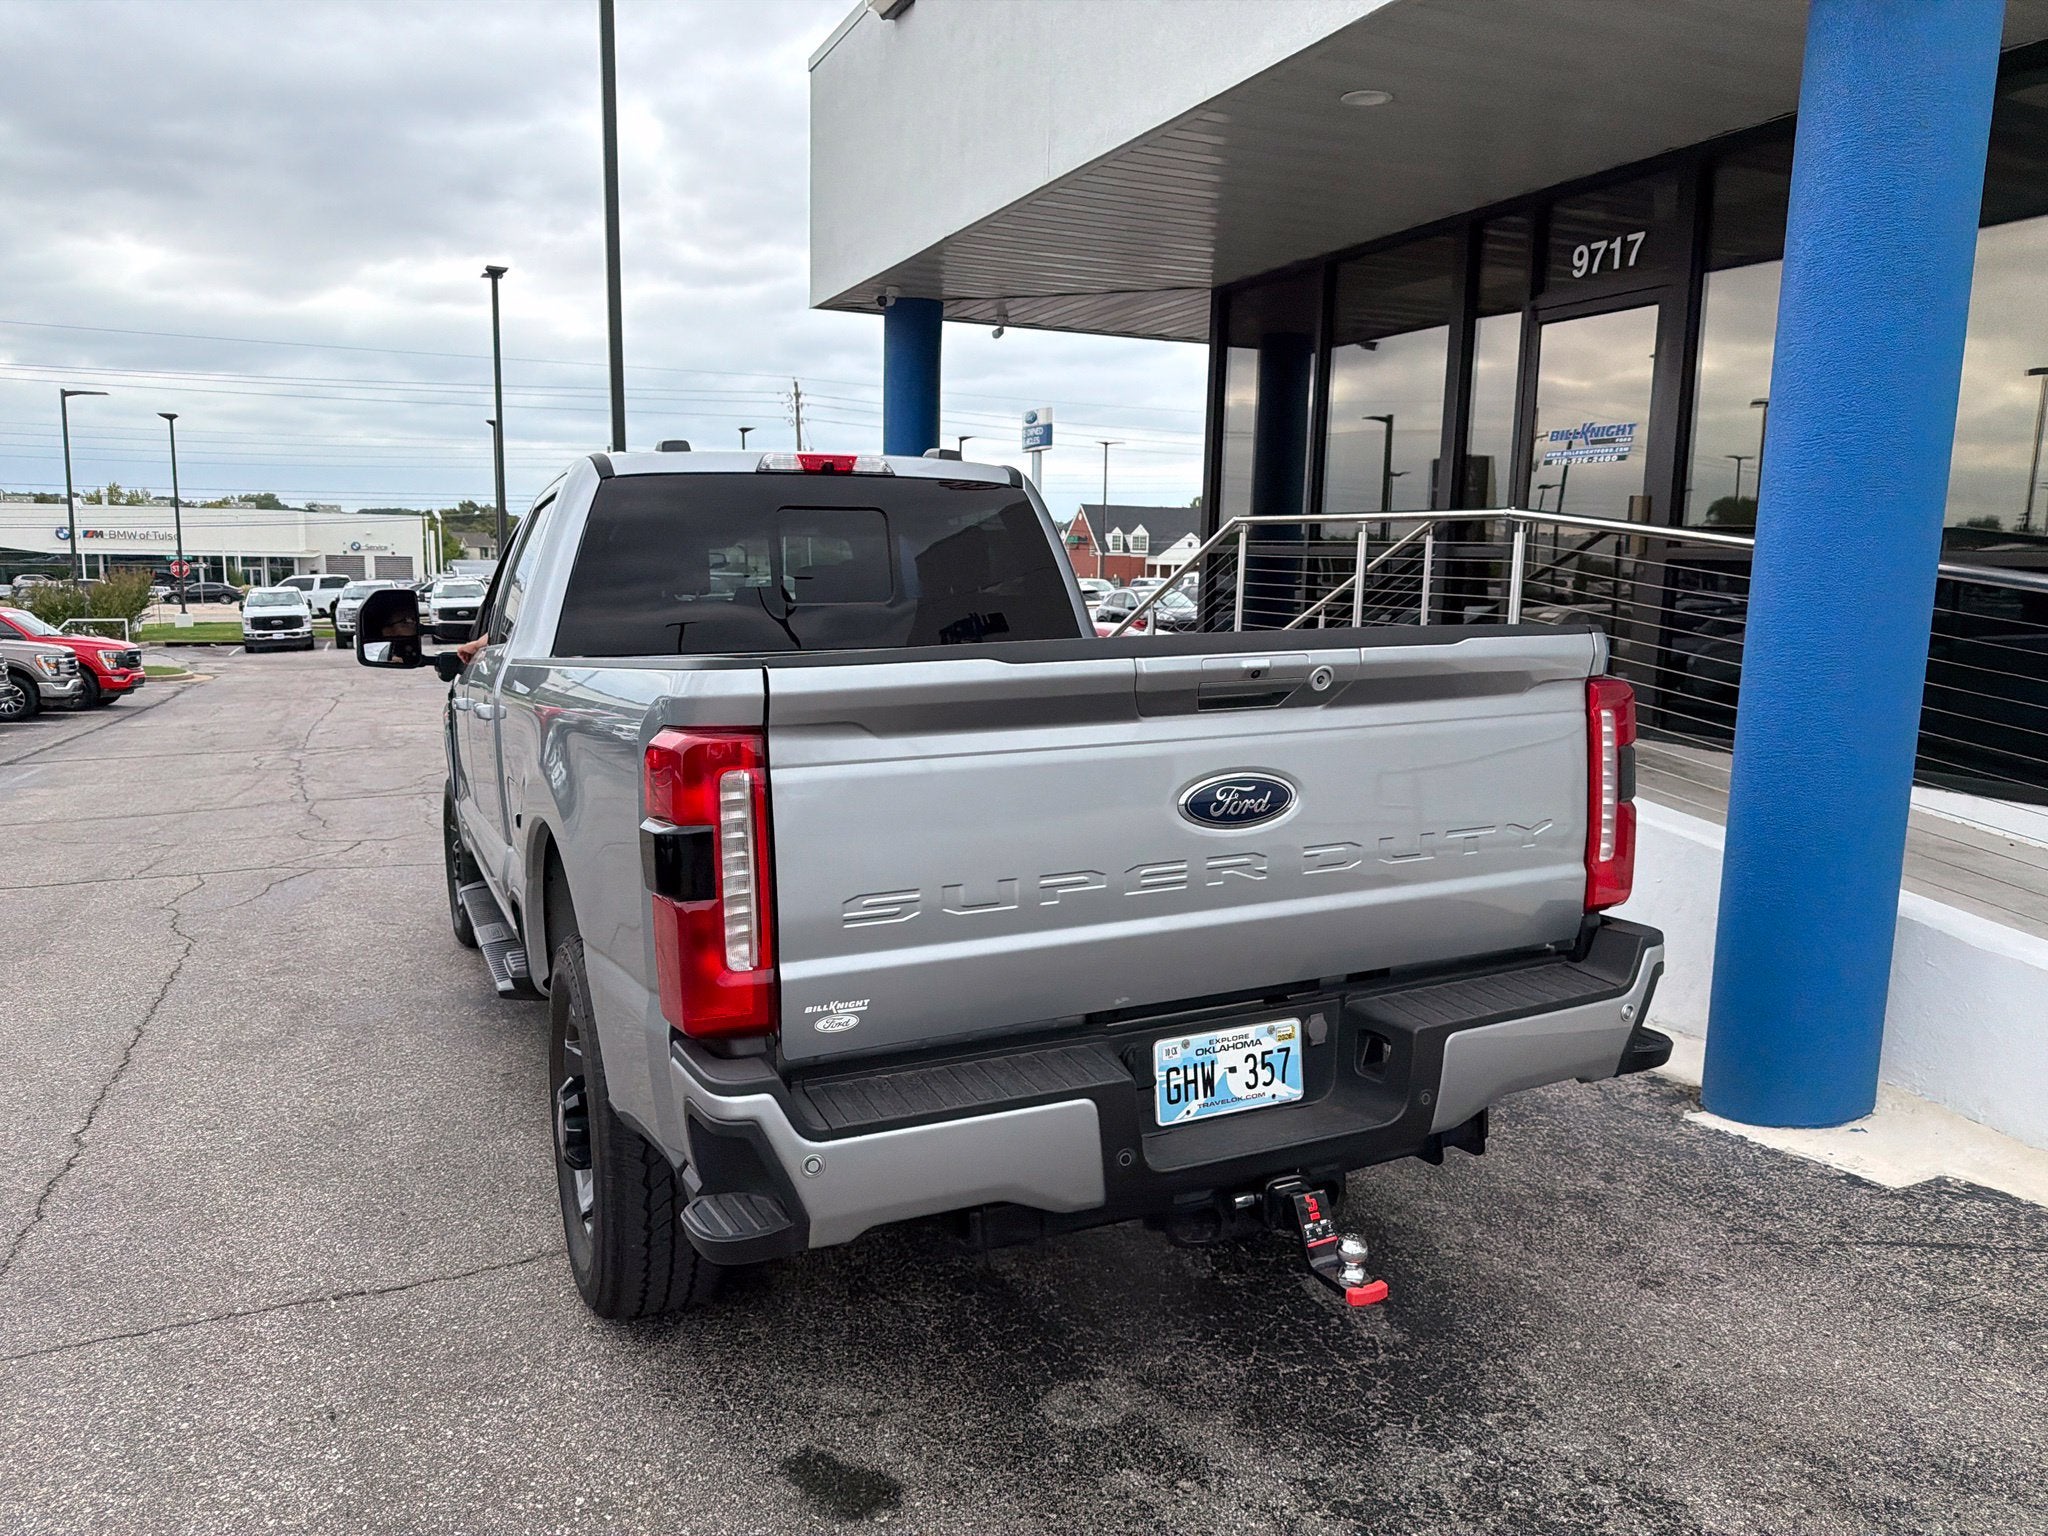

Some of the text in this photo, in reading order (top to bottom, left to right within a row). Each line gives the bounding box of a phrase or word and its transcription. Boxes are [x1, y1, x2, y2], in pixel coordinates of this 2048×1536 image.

[1572, 231, 1646, 278] 9717
[108, 530, 137, 540] BMW
[139, 531, 149, 540] of
[172, 565, 188, 573] STP
[1209, 785, 1272, 817] Ford
[842, 818, 1554, 929] SUPER DUTY
[1195, 1038, 1263, 1057] OKLAHOMA
[1209, 1033, 1250, 1046] EXPLORE
[1165, 1046, 1292, 1106] GHW 357
[1197, 1091, 1266, 1110] TRAVELOK.COM
